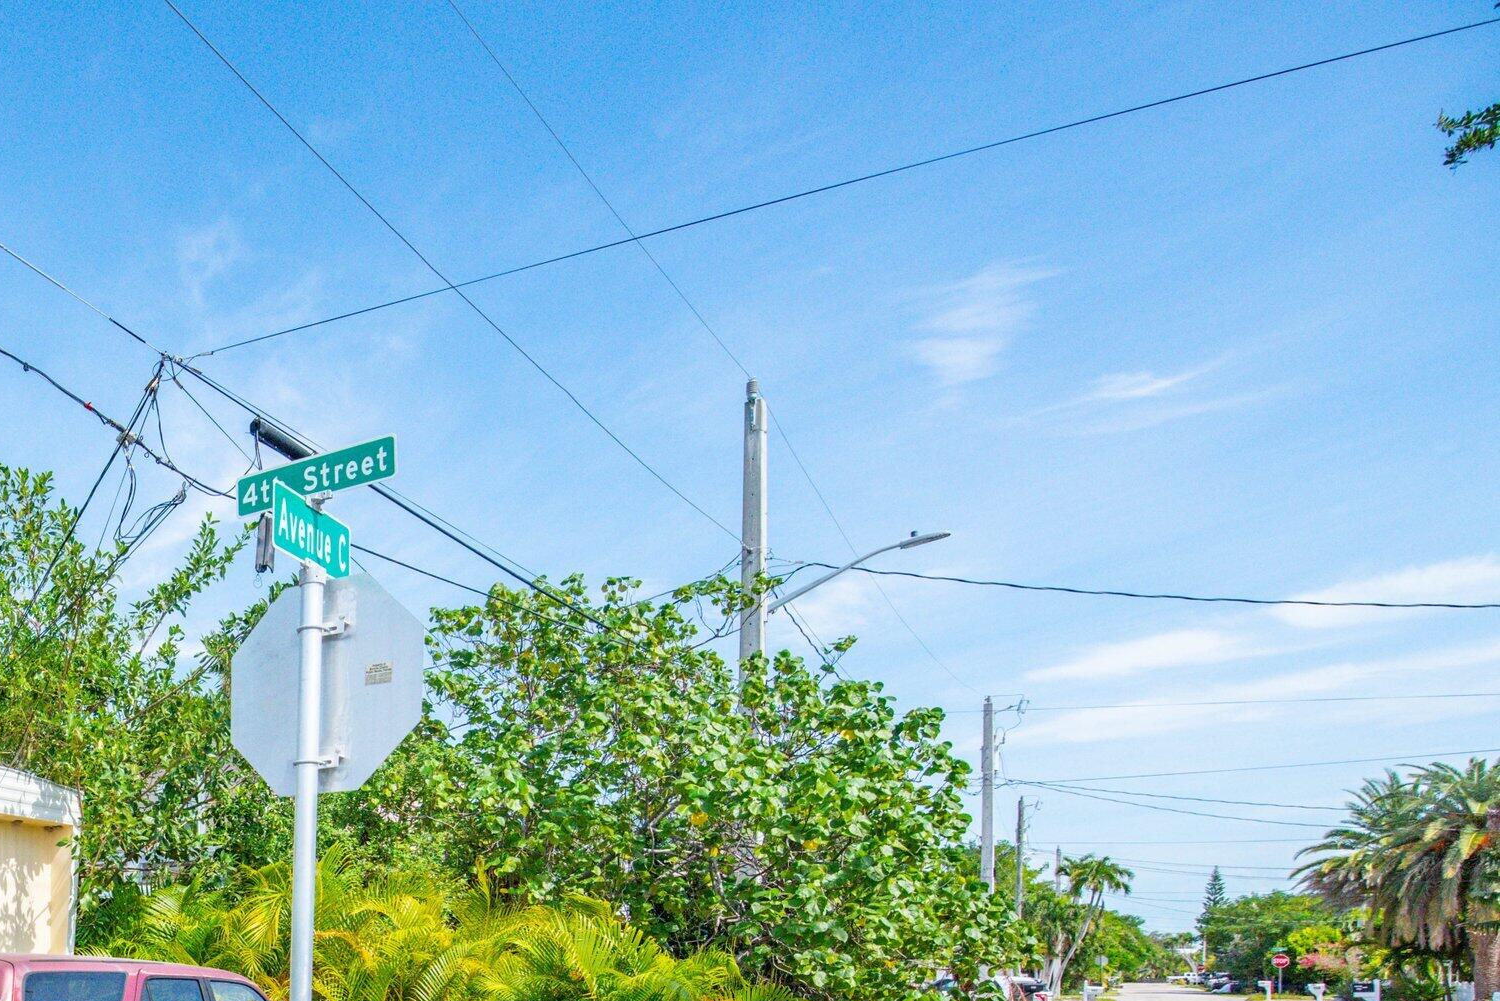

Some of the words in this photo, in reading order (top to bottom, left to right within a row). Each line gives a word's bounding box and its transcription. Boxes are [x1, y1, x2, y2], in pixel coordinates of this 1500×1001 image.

[242, 478, 271, 507] 4t
[303, 446, 388, 492] Street
[278, 497, 332, 564] Avenue
[338, 533, 347, 573] C
